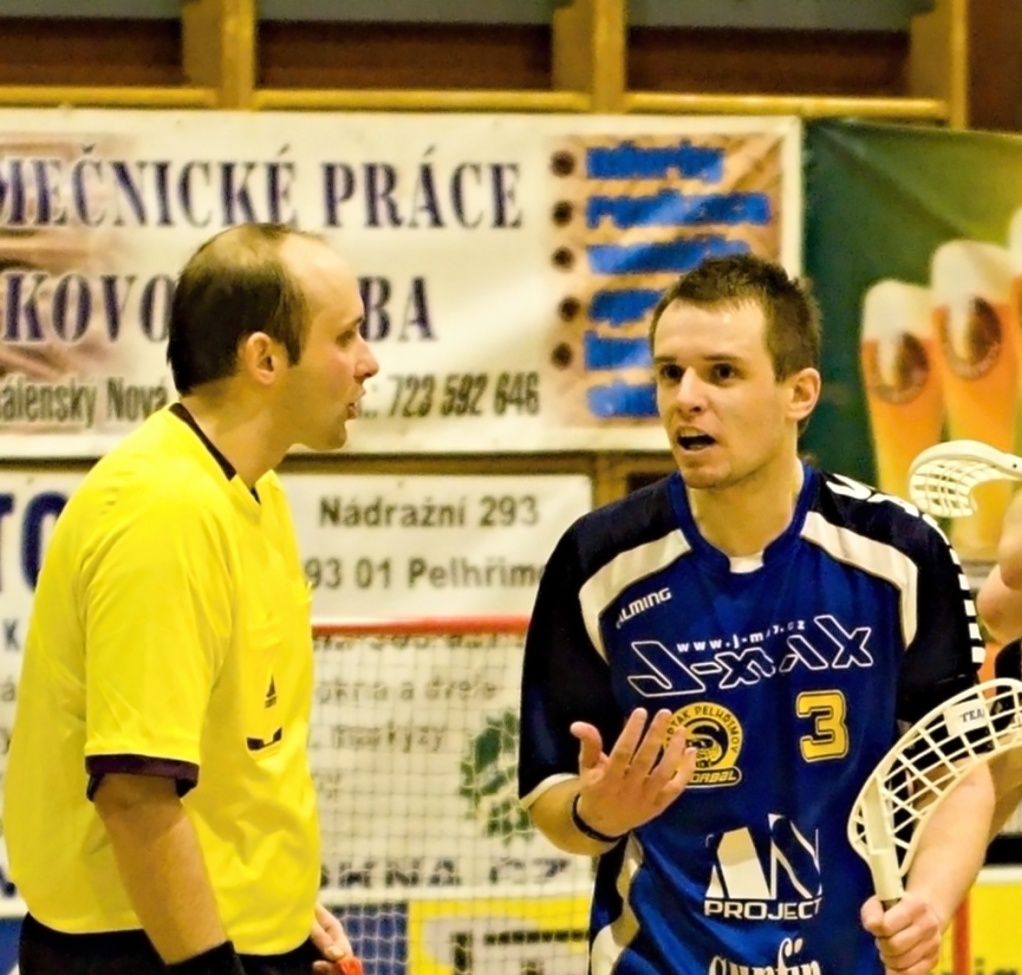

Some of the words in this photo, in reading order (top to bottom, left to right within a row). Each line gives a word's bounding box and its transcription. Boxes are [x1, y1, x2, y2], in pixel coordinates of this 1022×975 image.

[321, 144, 522, 229] PRÁCE
[388, 374, 436, 418] 723
[441, 373, 489, 417] 592
[494, 371, 541, 416] 646
[319, 496, 466, 527] Nádražní
[479, 496, 540, 527] 293
[305, 557, 342, 590] 93
[355, 557, 392, 589] 01
[408, 556, 544, 589] Pelhřim
[616, 587, 672, 629] LMING
[796, 689, 849, 763] 3
[704, 897, 823, 920] PROJECT
